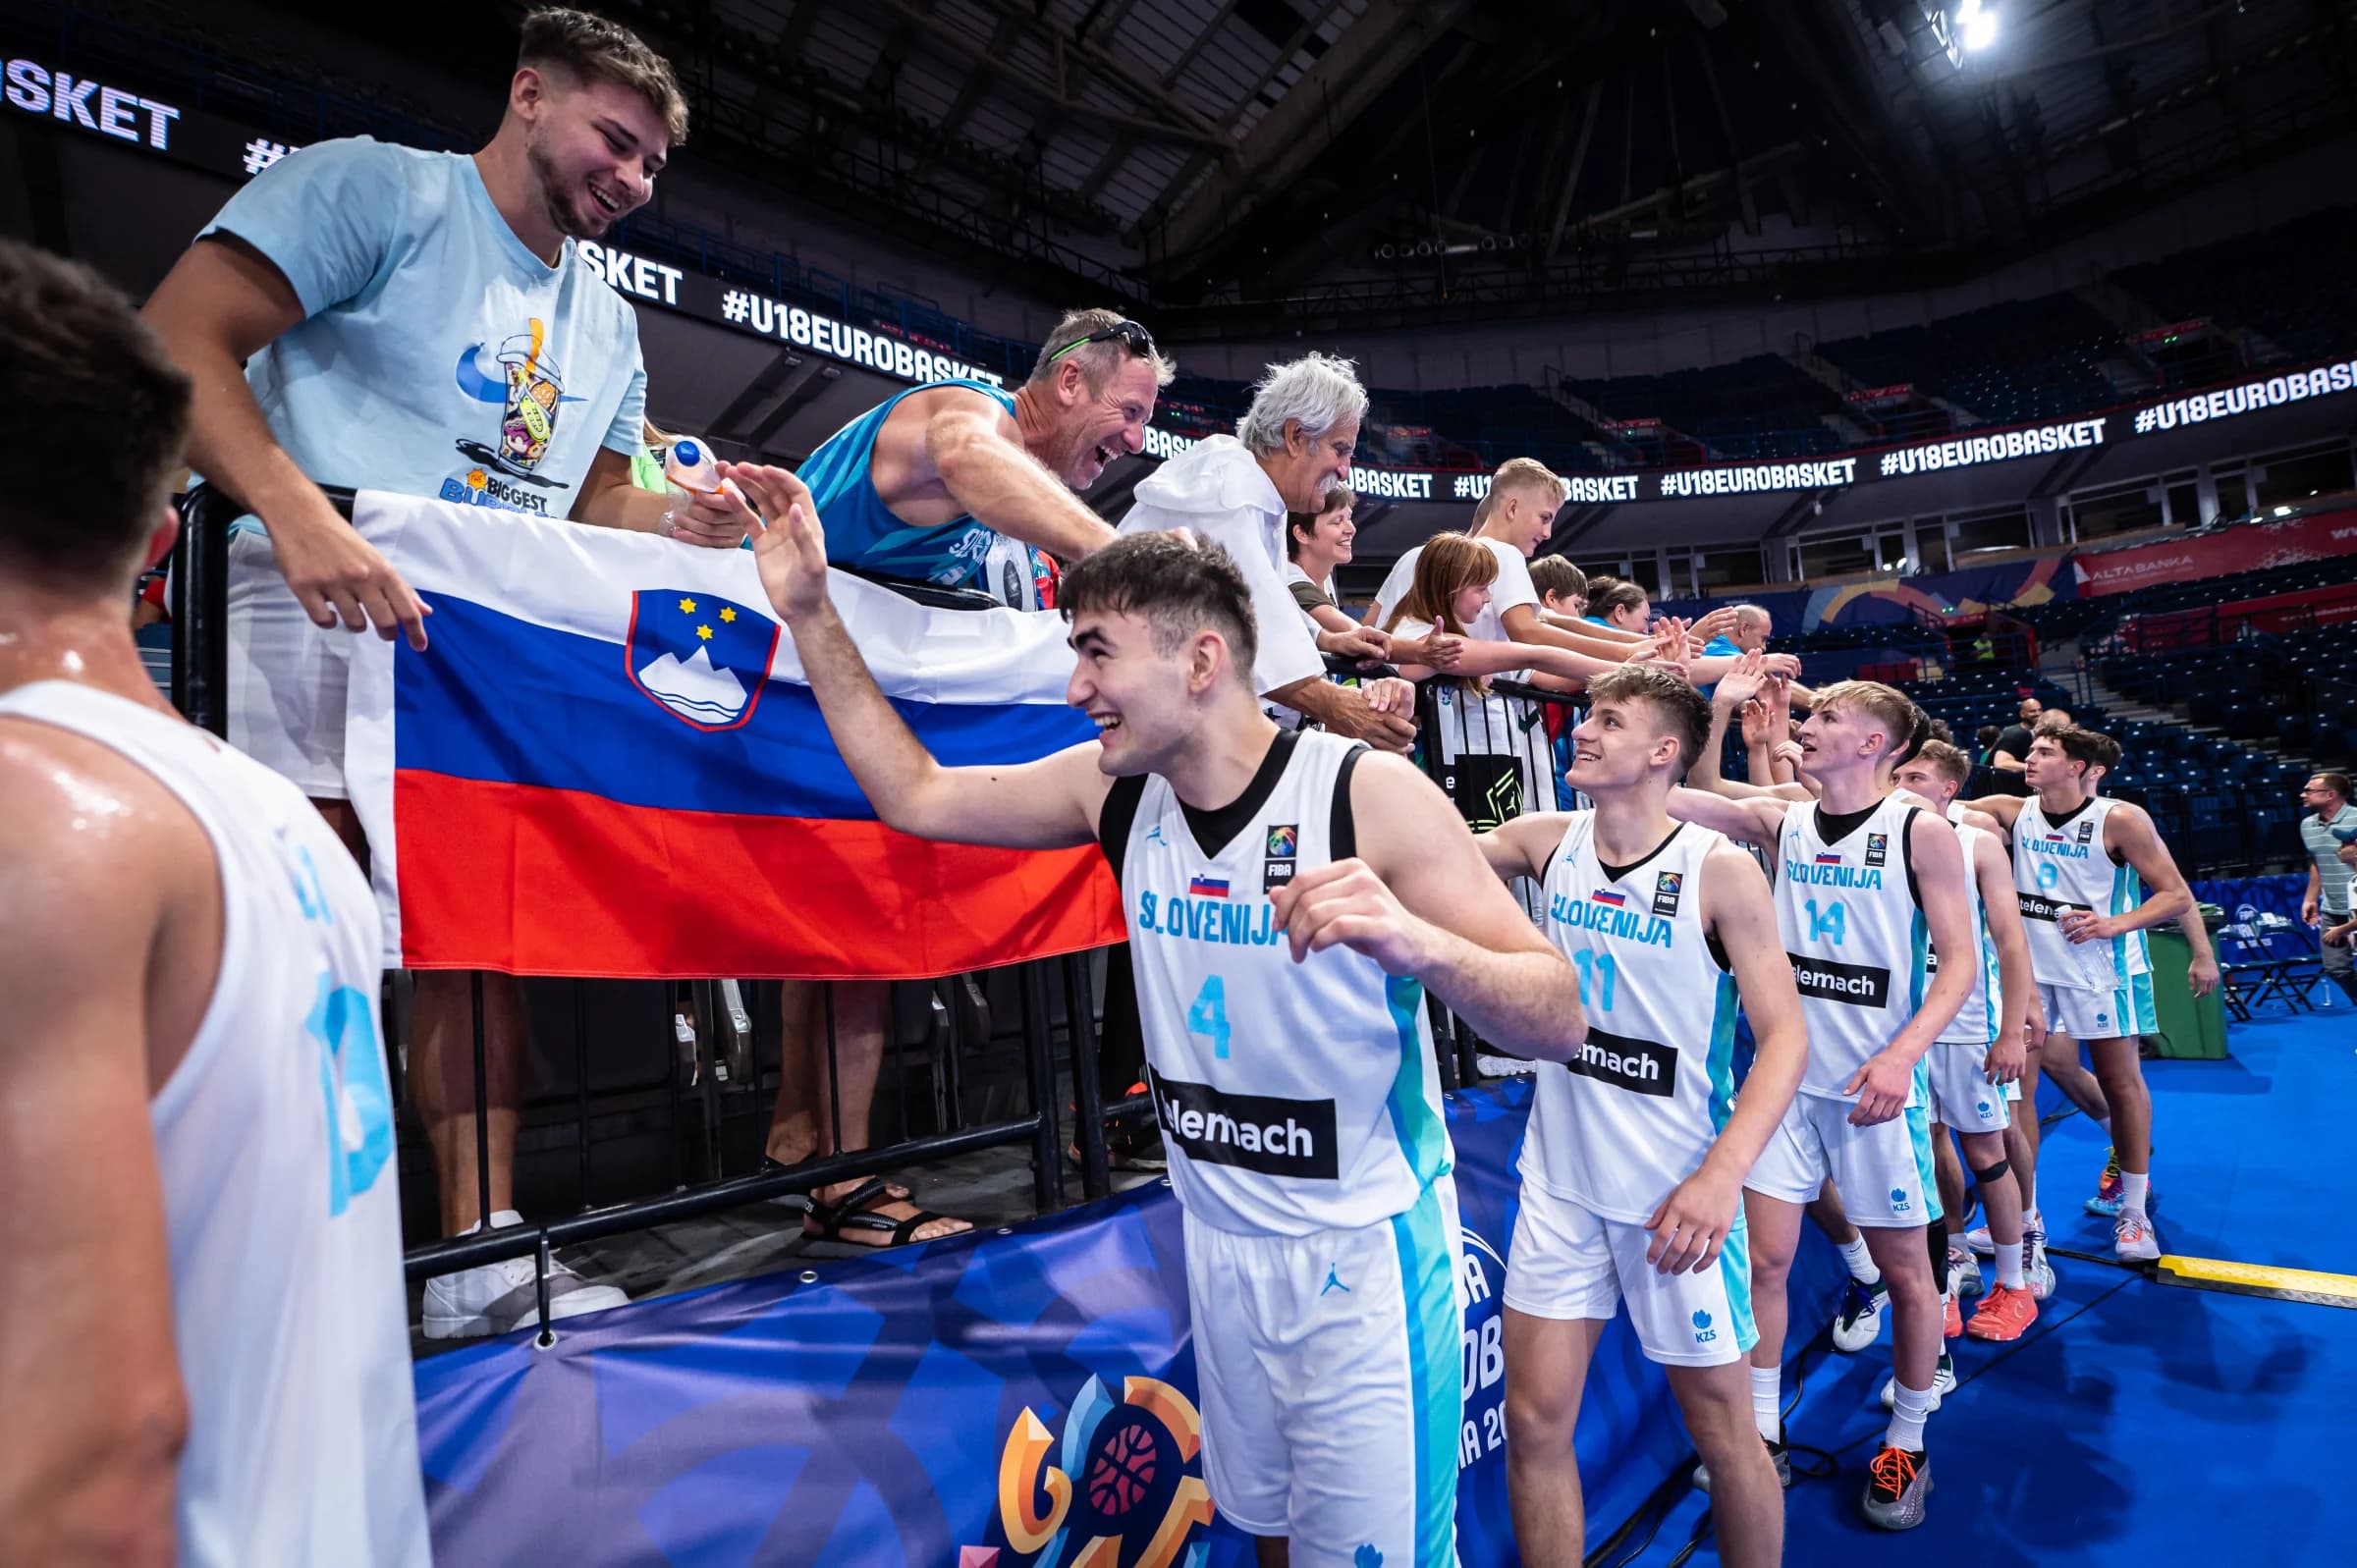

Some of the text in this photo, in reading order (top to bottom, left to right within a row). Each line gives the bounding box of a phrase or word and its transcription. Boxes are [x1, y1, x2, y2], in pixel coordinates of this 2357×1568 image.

[0, 59, 180, 150] SKET
[1881, 417, 2107, 476] #U18EUROBASKET
[488, 477, 548, 513] BIGGEST
[1661, 458, 1857, 496] #U18EUROBASKET
[1268, 863, 1292, 877] FIBA
[1786, 859, 1883, 891] SLOVENIJA
[1657, 894, 1676, 905] FIBA
[1804, 897, 1845, 946] 14
[1573, 947, 1617, 1012] 11
[1187, 973, 1232, 1059] 4
[1892, 1202, 1911, 1212] KZS
[1695, 1328, 1717, 1344] KZS
